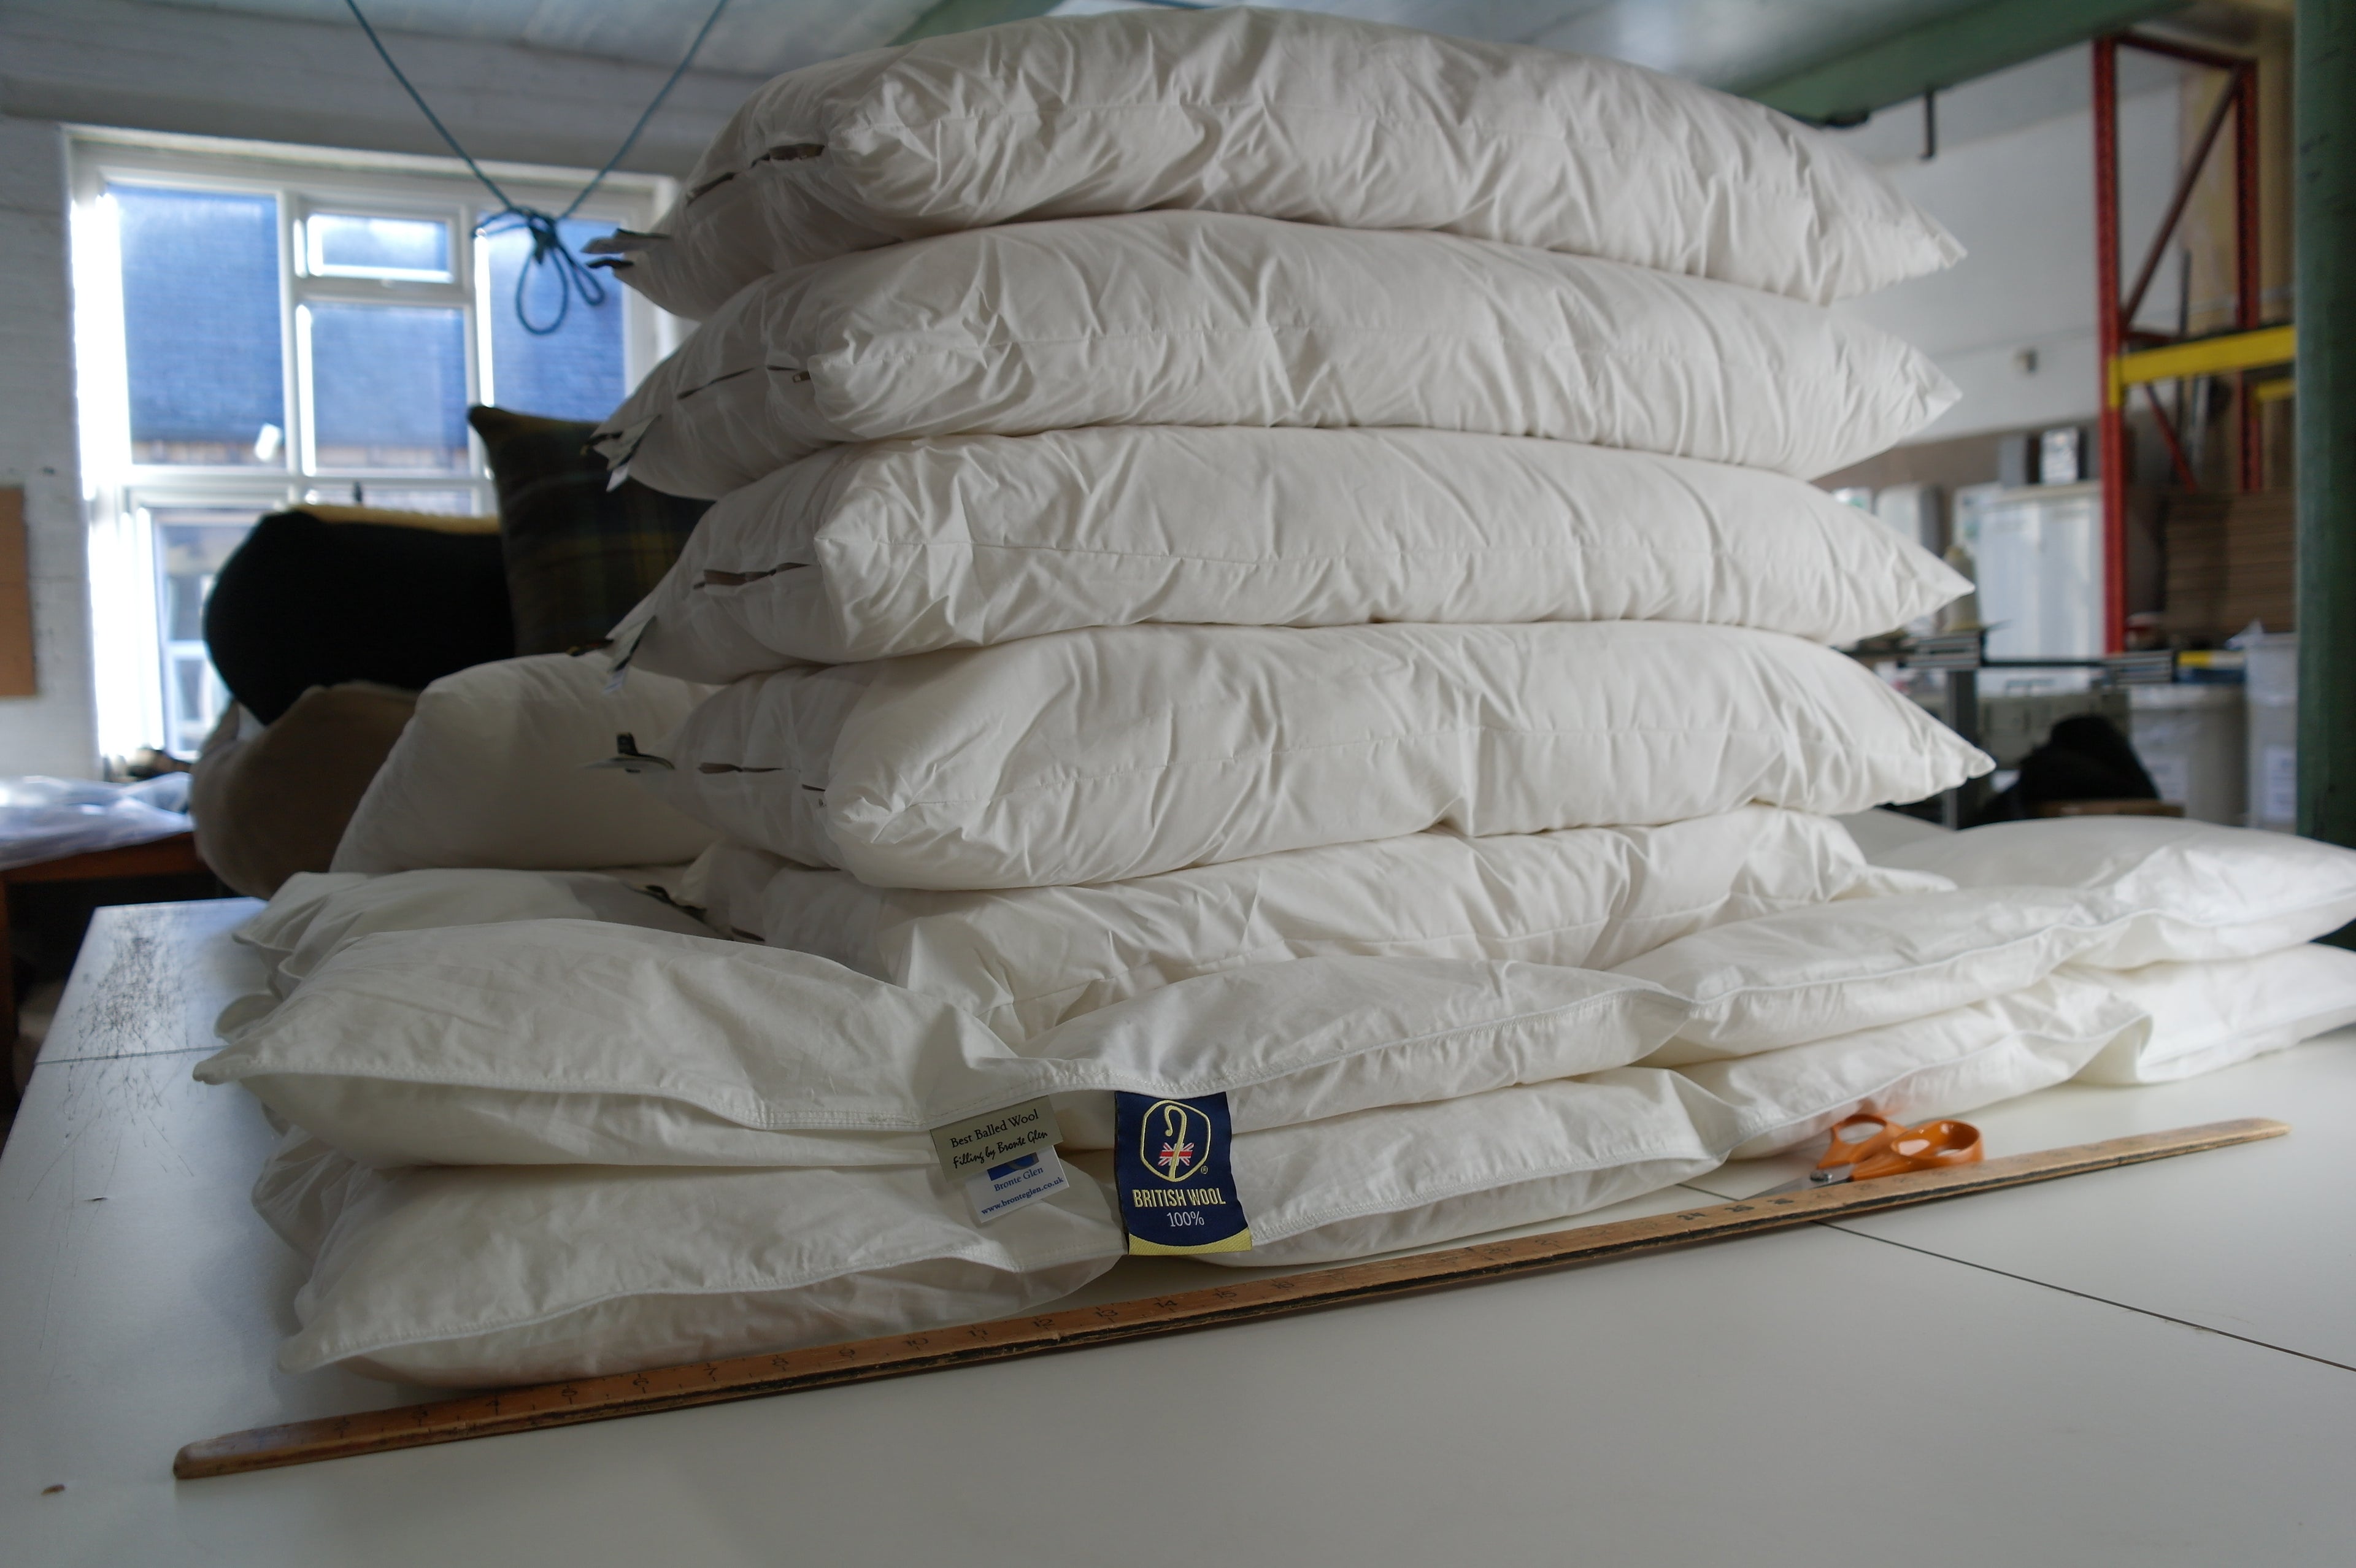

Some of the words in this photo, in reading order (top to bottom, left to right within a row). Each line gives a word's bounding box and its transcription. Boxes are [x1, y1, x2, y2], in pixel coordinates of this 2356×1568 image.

[950, 1135, 973, 1148] Best
[974, 1120, 1007, 1140] Balled
[1008, 1109, 1039, 1128] Wool
[985, 1146, 996, 1160] by
[996, 1136, 1026, 1153] Bronte
[1027, 1129, 1048, 1143] Glen
[994, 1176, 1022, 1191] Bronte
[1023, 1167, 1044, 1180] Glen
[982, 1177, 1064, 1215] www.bronteglen.co.uk
[1132, 1189, 1187, 1207] BRITISH
[1187, 1188, 1226, 1205] WOOL
[1167, 1211, 1204, 1227] 100%
[1093, 1309, 1119, 1318] 13
[1153, 1299, 1178, 1309] 14
[1212, 1290, 1238, 1299] 15
